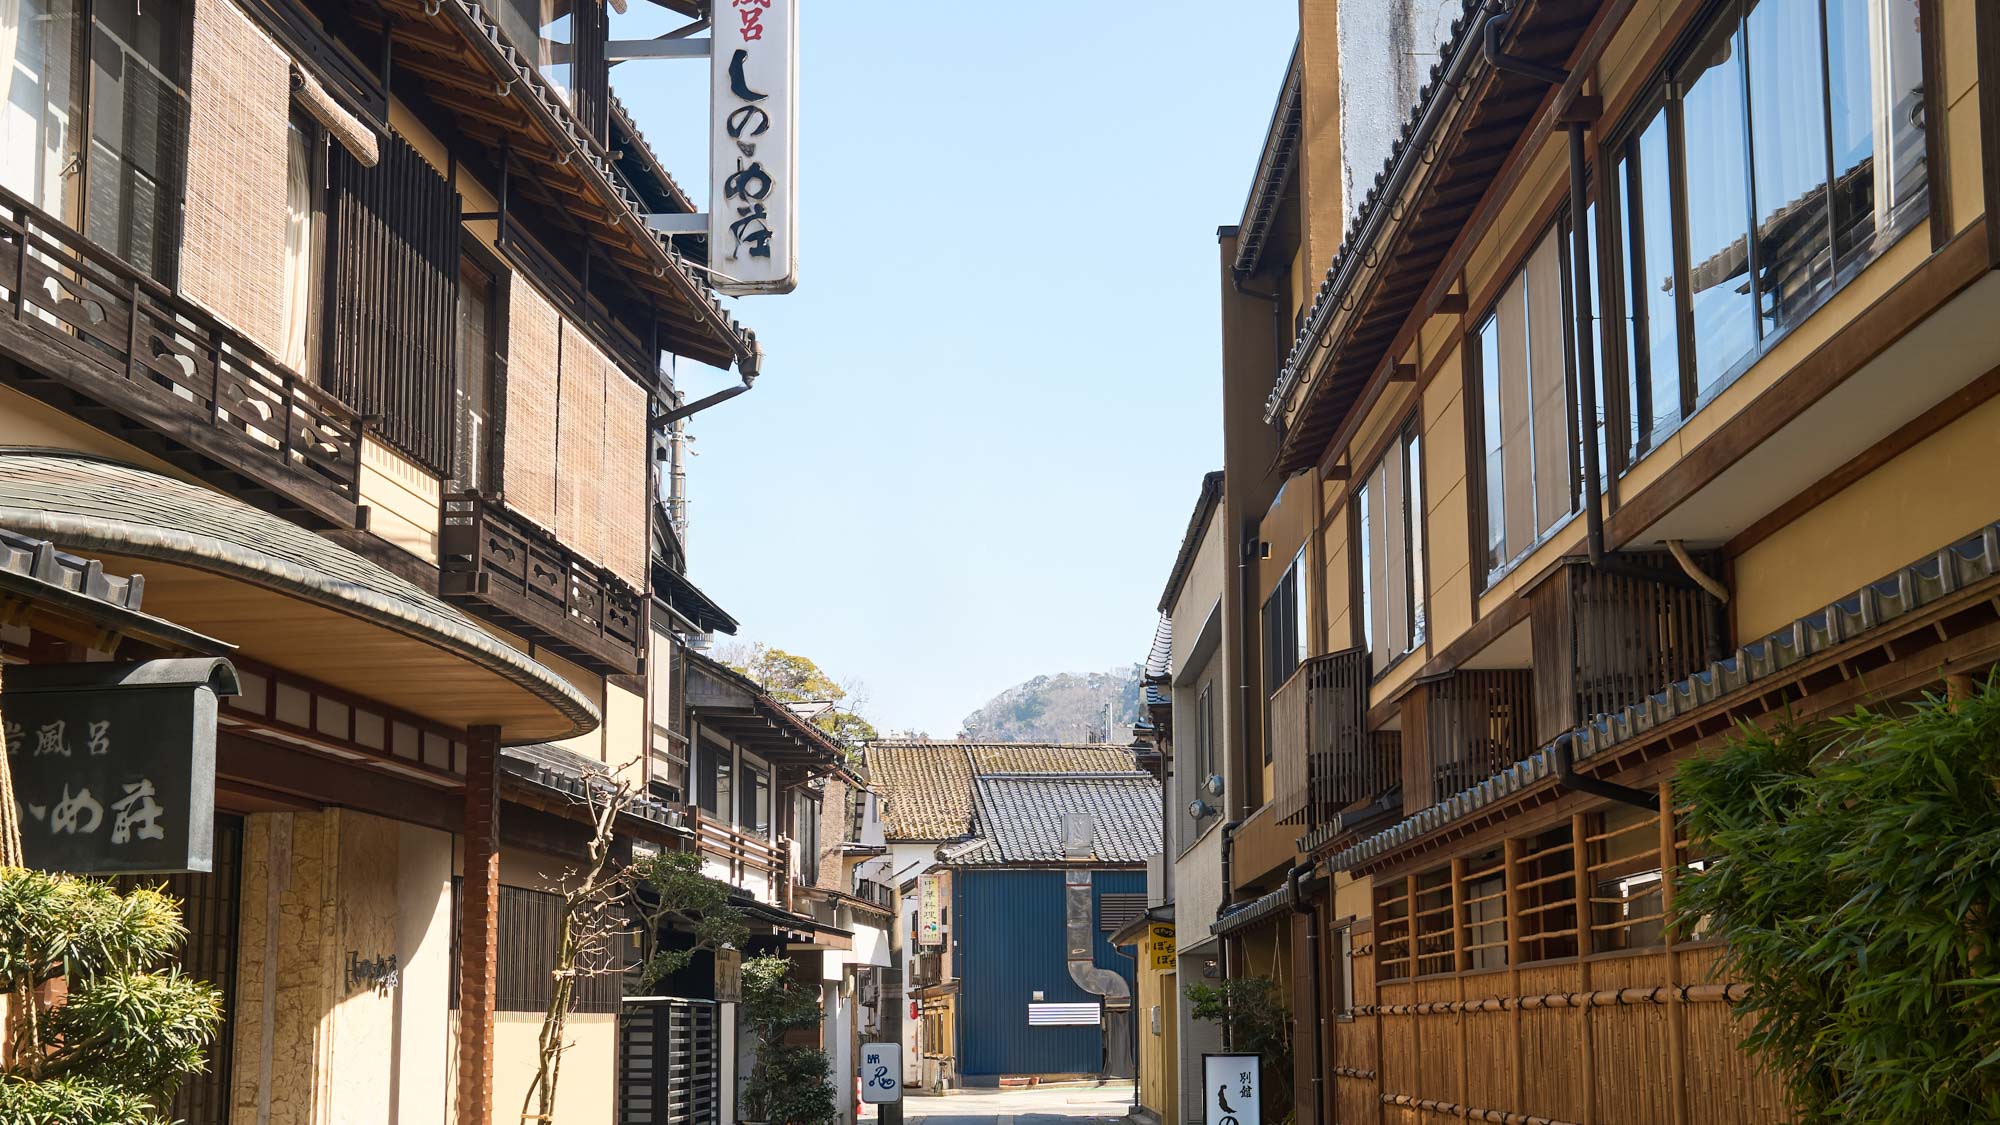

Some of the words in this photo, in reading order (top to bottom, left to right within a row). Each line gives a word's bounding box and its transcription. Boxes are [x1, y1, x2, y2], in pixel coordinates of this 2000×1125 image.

[732, 0, 771, 42] 呂
[867, 1054, 880, 1064] BAR
[868, 1066, 895, 1089] Ryo
[1239, 1071, 1252, 1098] 別館
